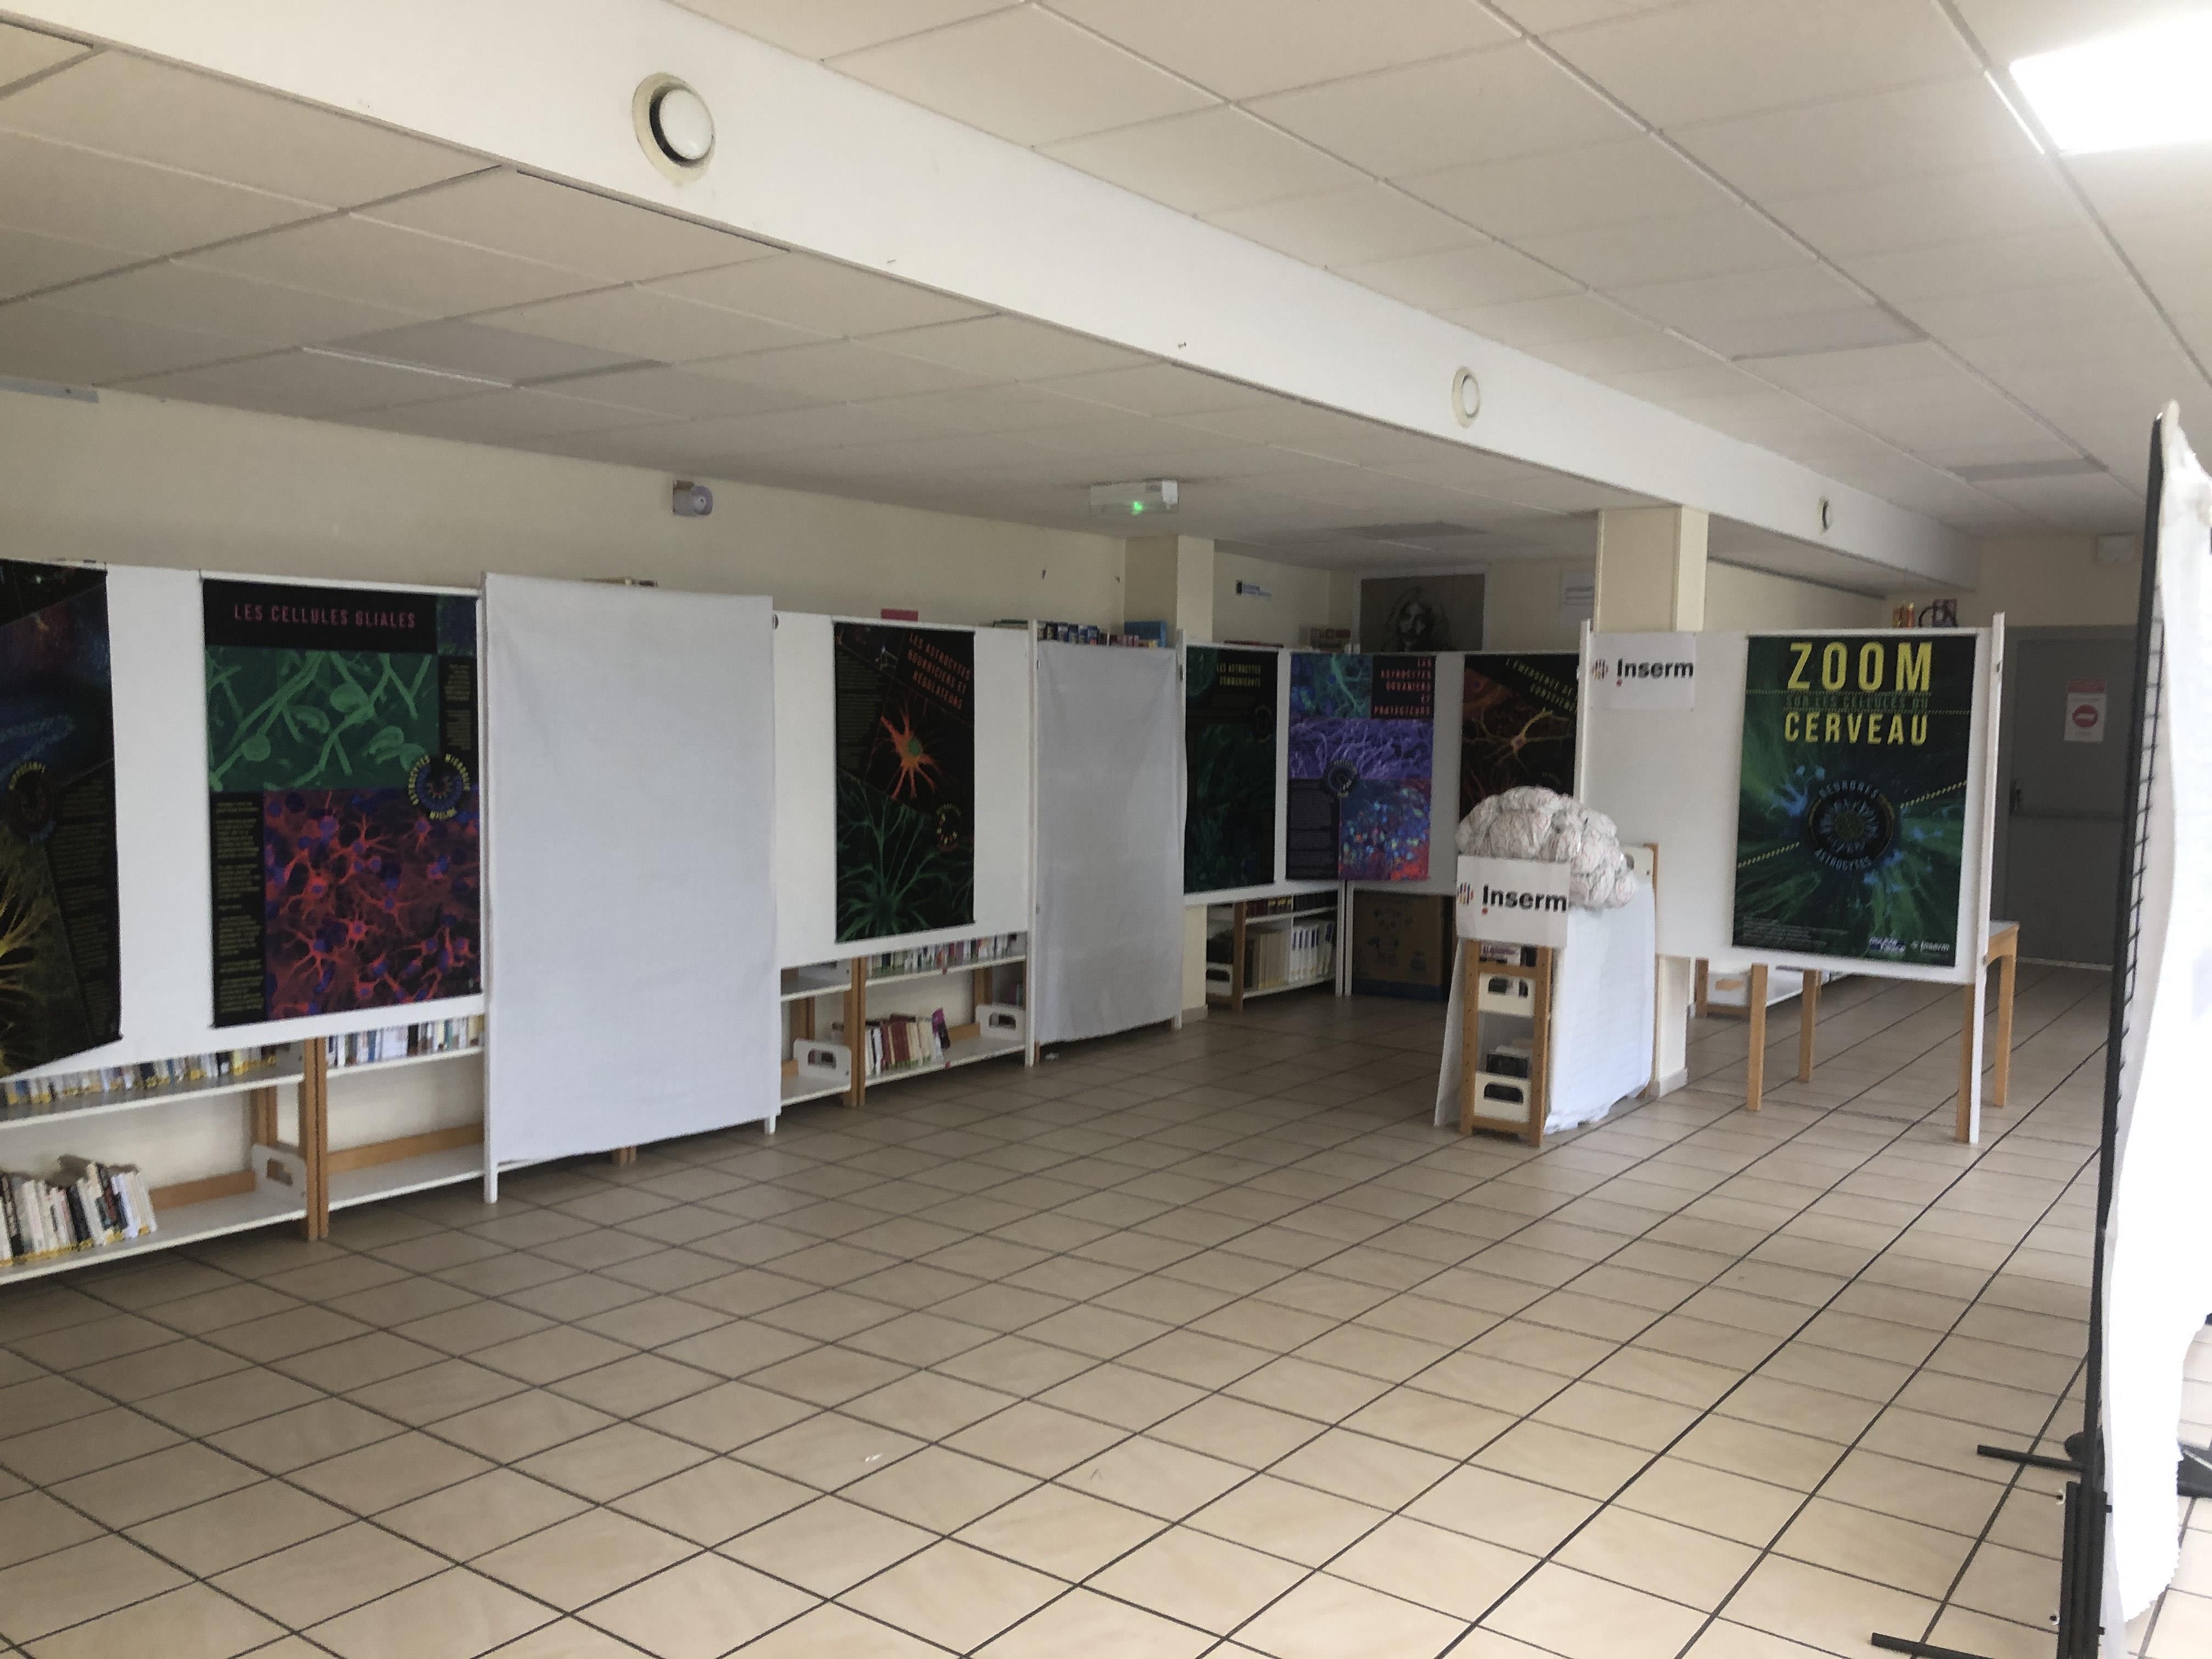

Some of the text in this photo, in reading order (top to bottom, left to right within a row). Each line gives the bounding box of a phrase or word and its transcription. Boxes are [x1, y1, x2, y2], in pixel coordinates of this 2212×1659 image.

[234, 604, 263, 622] LES
[271, 605, 348, 625] CELLULES
[1616, 658, 1694, 686] Inserm
[1787, 641, 1933, 692] ZOOM
[1784, 711, 1929, 746] CERVEAU
[1482, 884, 1567, 915] Inserm
